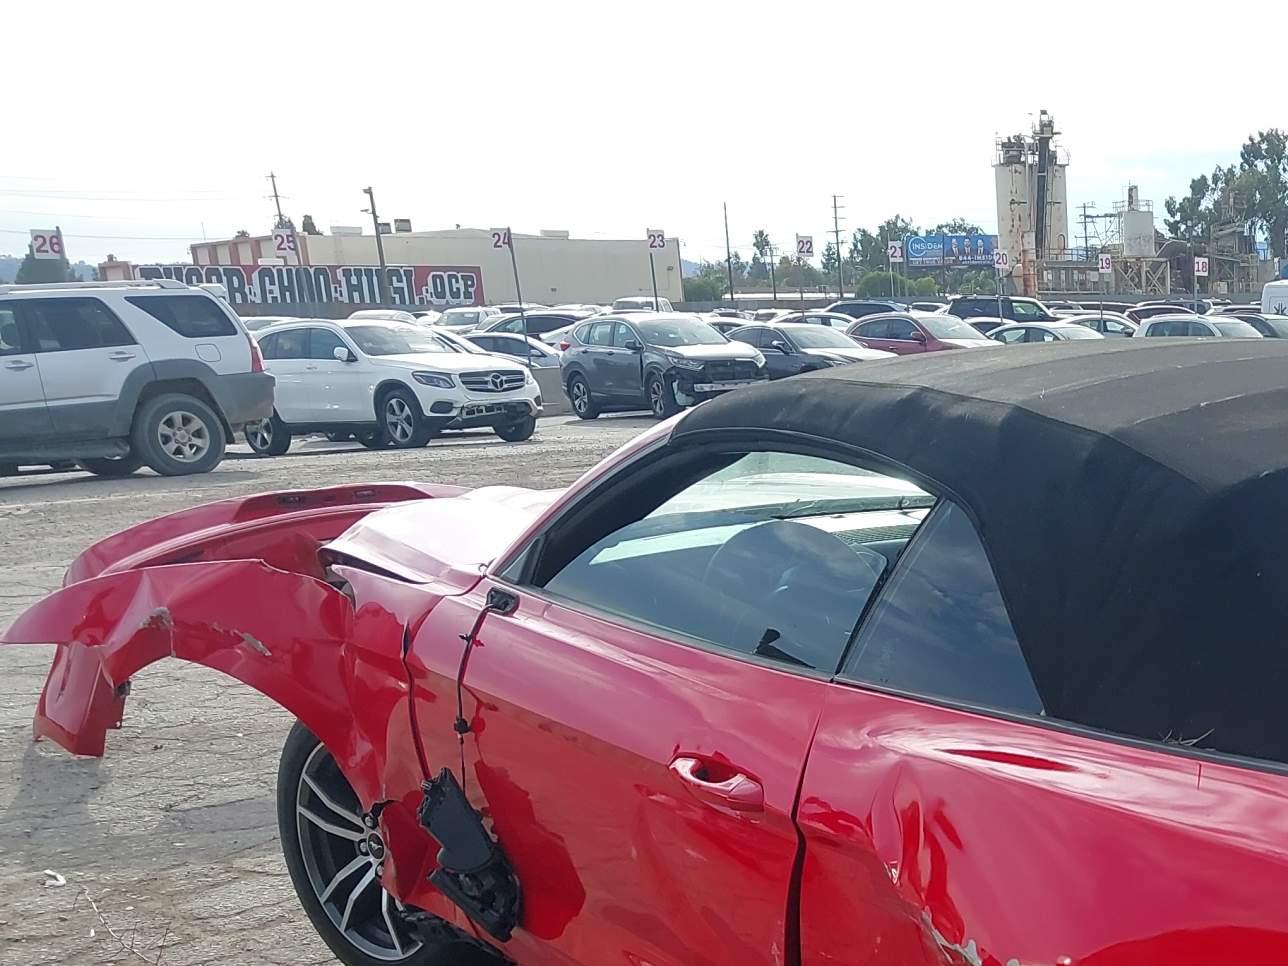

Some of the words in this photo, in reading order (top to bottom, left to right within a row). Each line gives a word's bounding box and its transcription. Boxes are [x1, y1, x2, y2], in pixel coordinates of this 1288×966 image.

[33, 234, 61, 253] 26
[274, 233, 295, 250] 25
[492, 232, 511, 248] 24
[648, 233, 665, 248] 23
[798, 239, 813, 253] 22
[890, 245, 903, 258] 21
[995, 252, 1008, 265] 20
[1100, 257, 1111, 269] 19
[1195, 261, 1208, 272] 18
